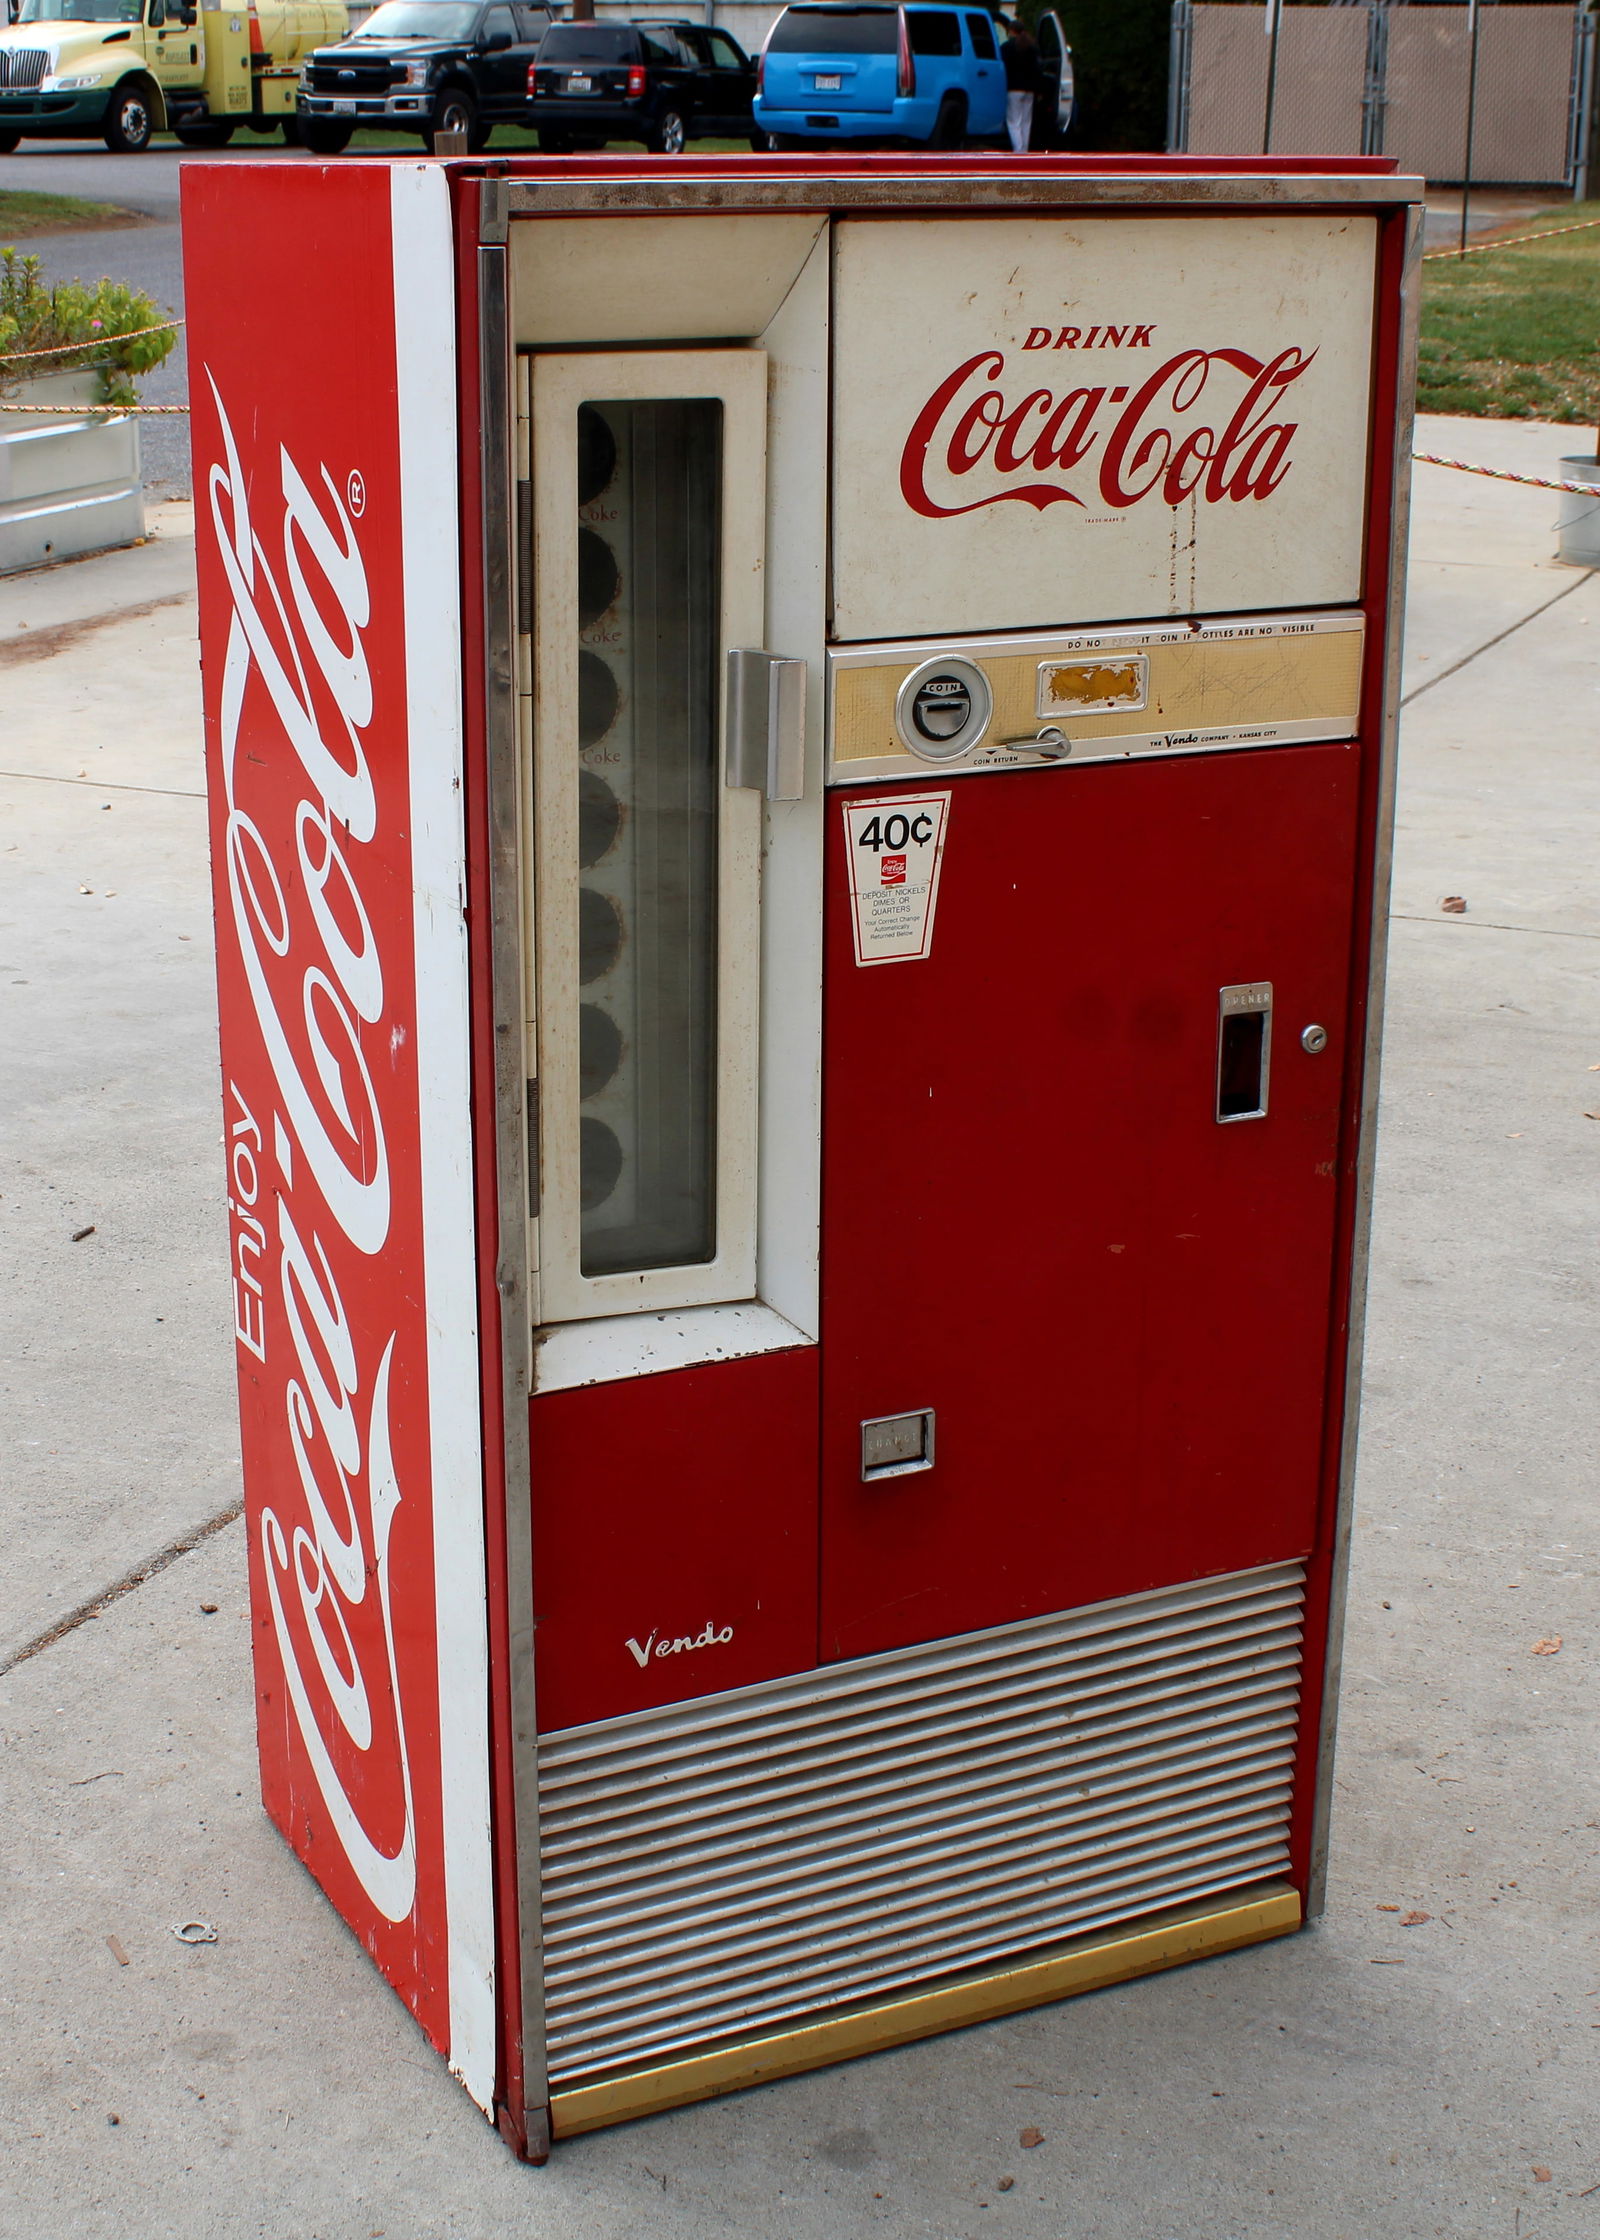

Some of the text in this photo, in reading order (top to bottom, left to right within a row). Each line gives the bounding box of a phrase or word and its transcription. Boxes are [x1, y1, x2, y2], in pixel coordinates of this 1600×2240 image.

[1021, 325, 1158, 350] DRINK
[900, 344, 1320, 519] Coca-Cola
[578, 505, 618, 521] Coke
[581, 630, 622, 645] Coke
[1238, 628, 1254, 636] ARE
[1282, 624, 1315, 633] VISIBLE
[929, 683, 958, 692] COIN
[1163, 733, 1199, 748] Vendo
[1200, 734, 1229, 742] COMPANY
[1238, 731, 1261, 739] KANSAS
[582, 749, 621, 766] Coke
[973, 755, 1019, 766] COIN RETURN
[858, 812, 933, 853] 40¢
[862, 886, 926, 900] DEPOSIT NICKELS
[873, 896, 910, 907] DIMES OR
[871, 905, 911, 916] QUARTERS
[874, 924, 910, 932] Automatically
[878, 917, 899, 925] Correct
[1224, 992, 1270, 1008] OPENER
[203, 361, 416, 1923] Coca-Cola
[228, 1079, 267, 1374] Enjoy
[624, 1621, 734, 1668] Vendo
